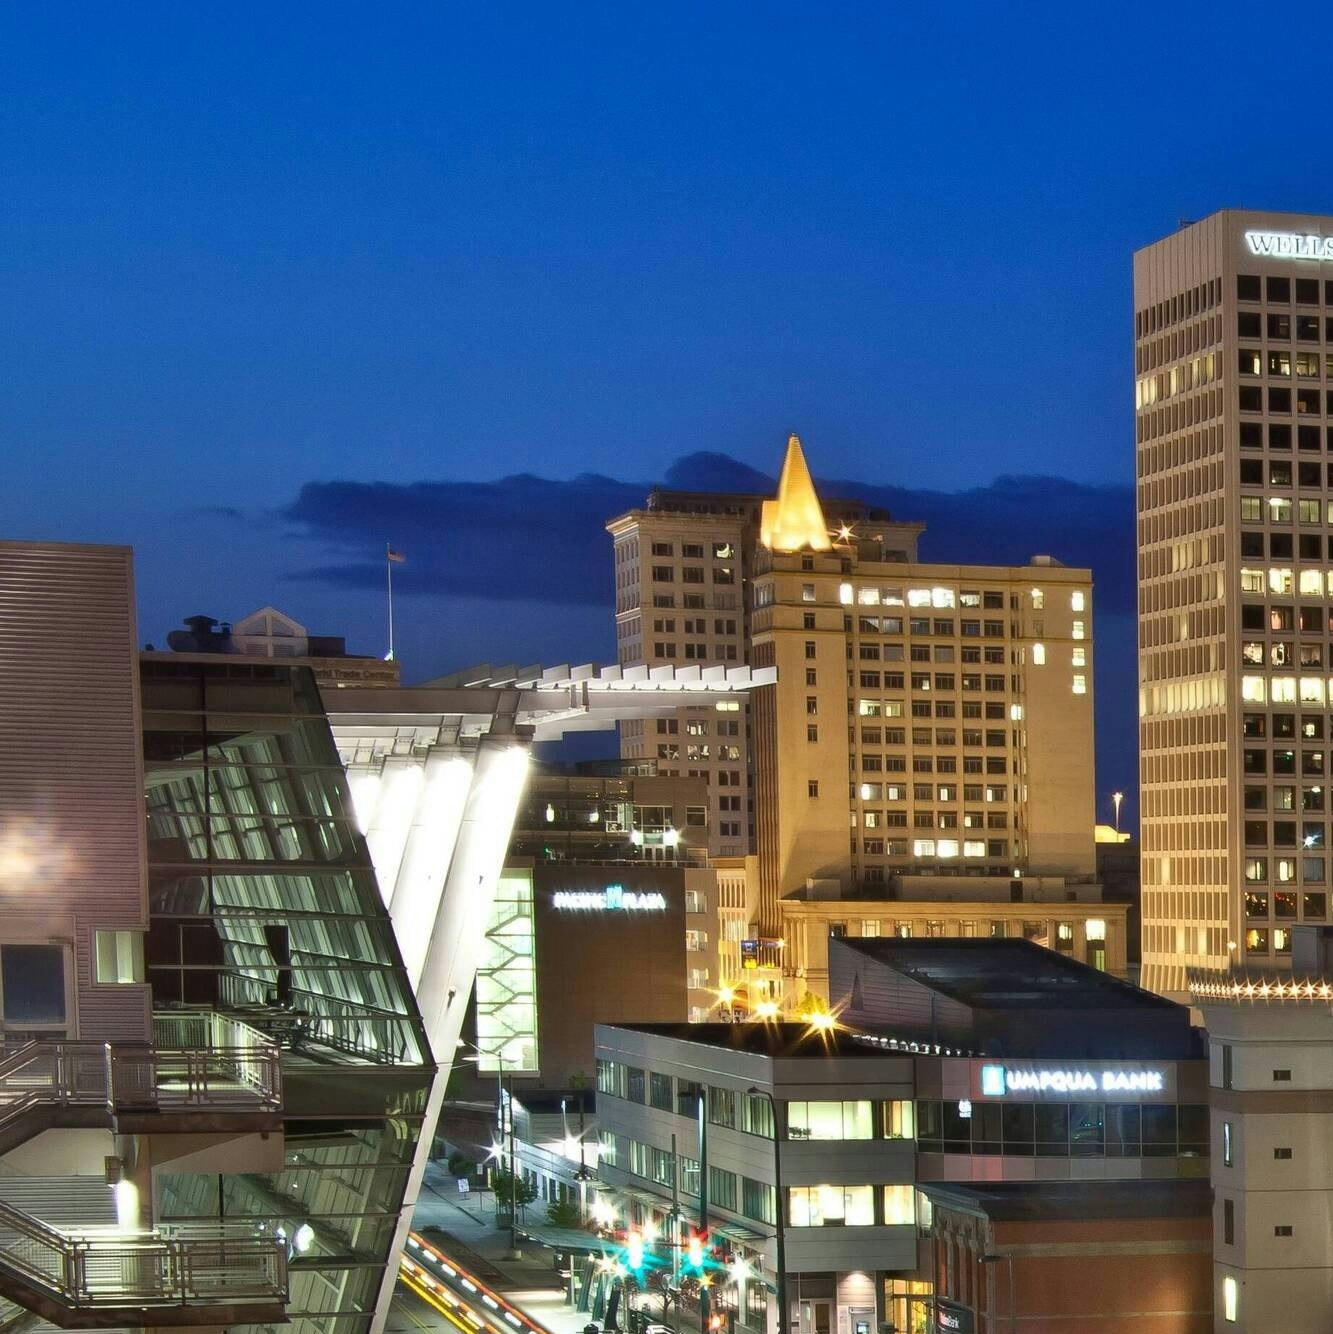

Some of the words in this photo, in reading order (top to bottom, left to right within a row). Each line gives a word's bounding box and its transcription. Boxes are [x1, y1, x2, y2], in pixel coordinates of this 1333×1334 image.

[622, 892, 667, 909] PLAZA
[1006, 1070, 1097, 1092] UMPQUA
[1102, 1070, 1163, 1091] BANK
